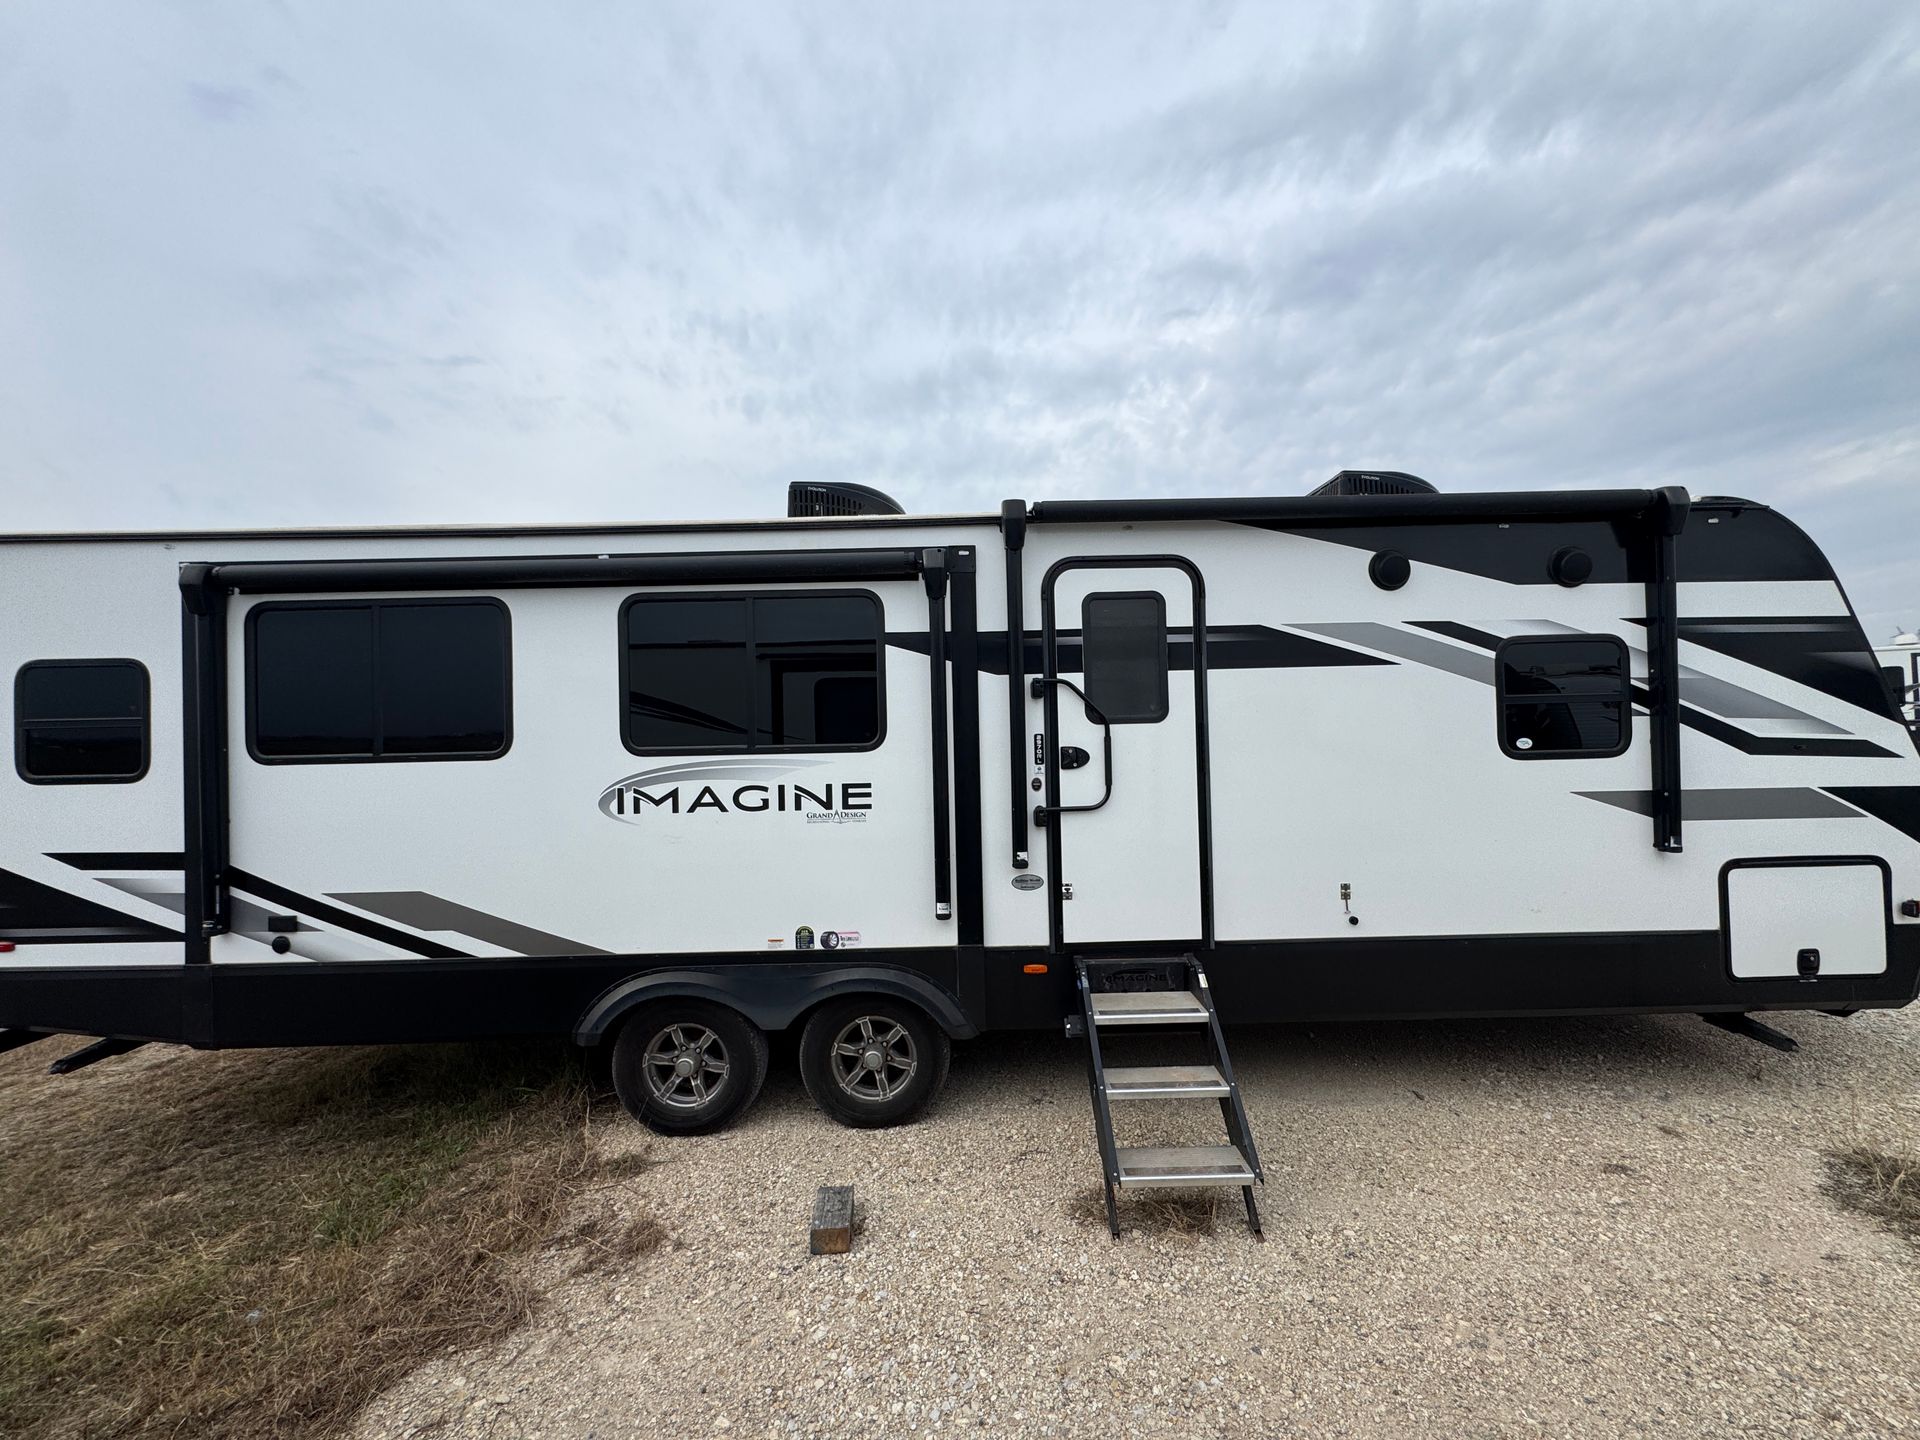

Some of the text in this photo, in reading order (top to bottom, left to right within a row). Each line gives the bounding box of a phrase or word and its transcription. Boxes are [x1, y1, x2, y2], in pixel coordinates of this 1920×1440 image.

[616, 782, 873, 815] IMAGINE
[806, 811, 867, 819] GRAND DESIGN
[1107, 974, 1168, 982] IMAGINE
